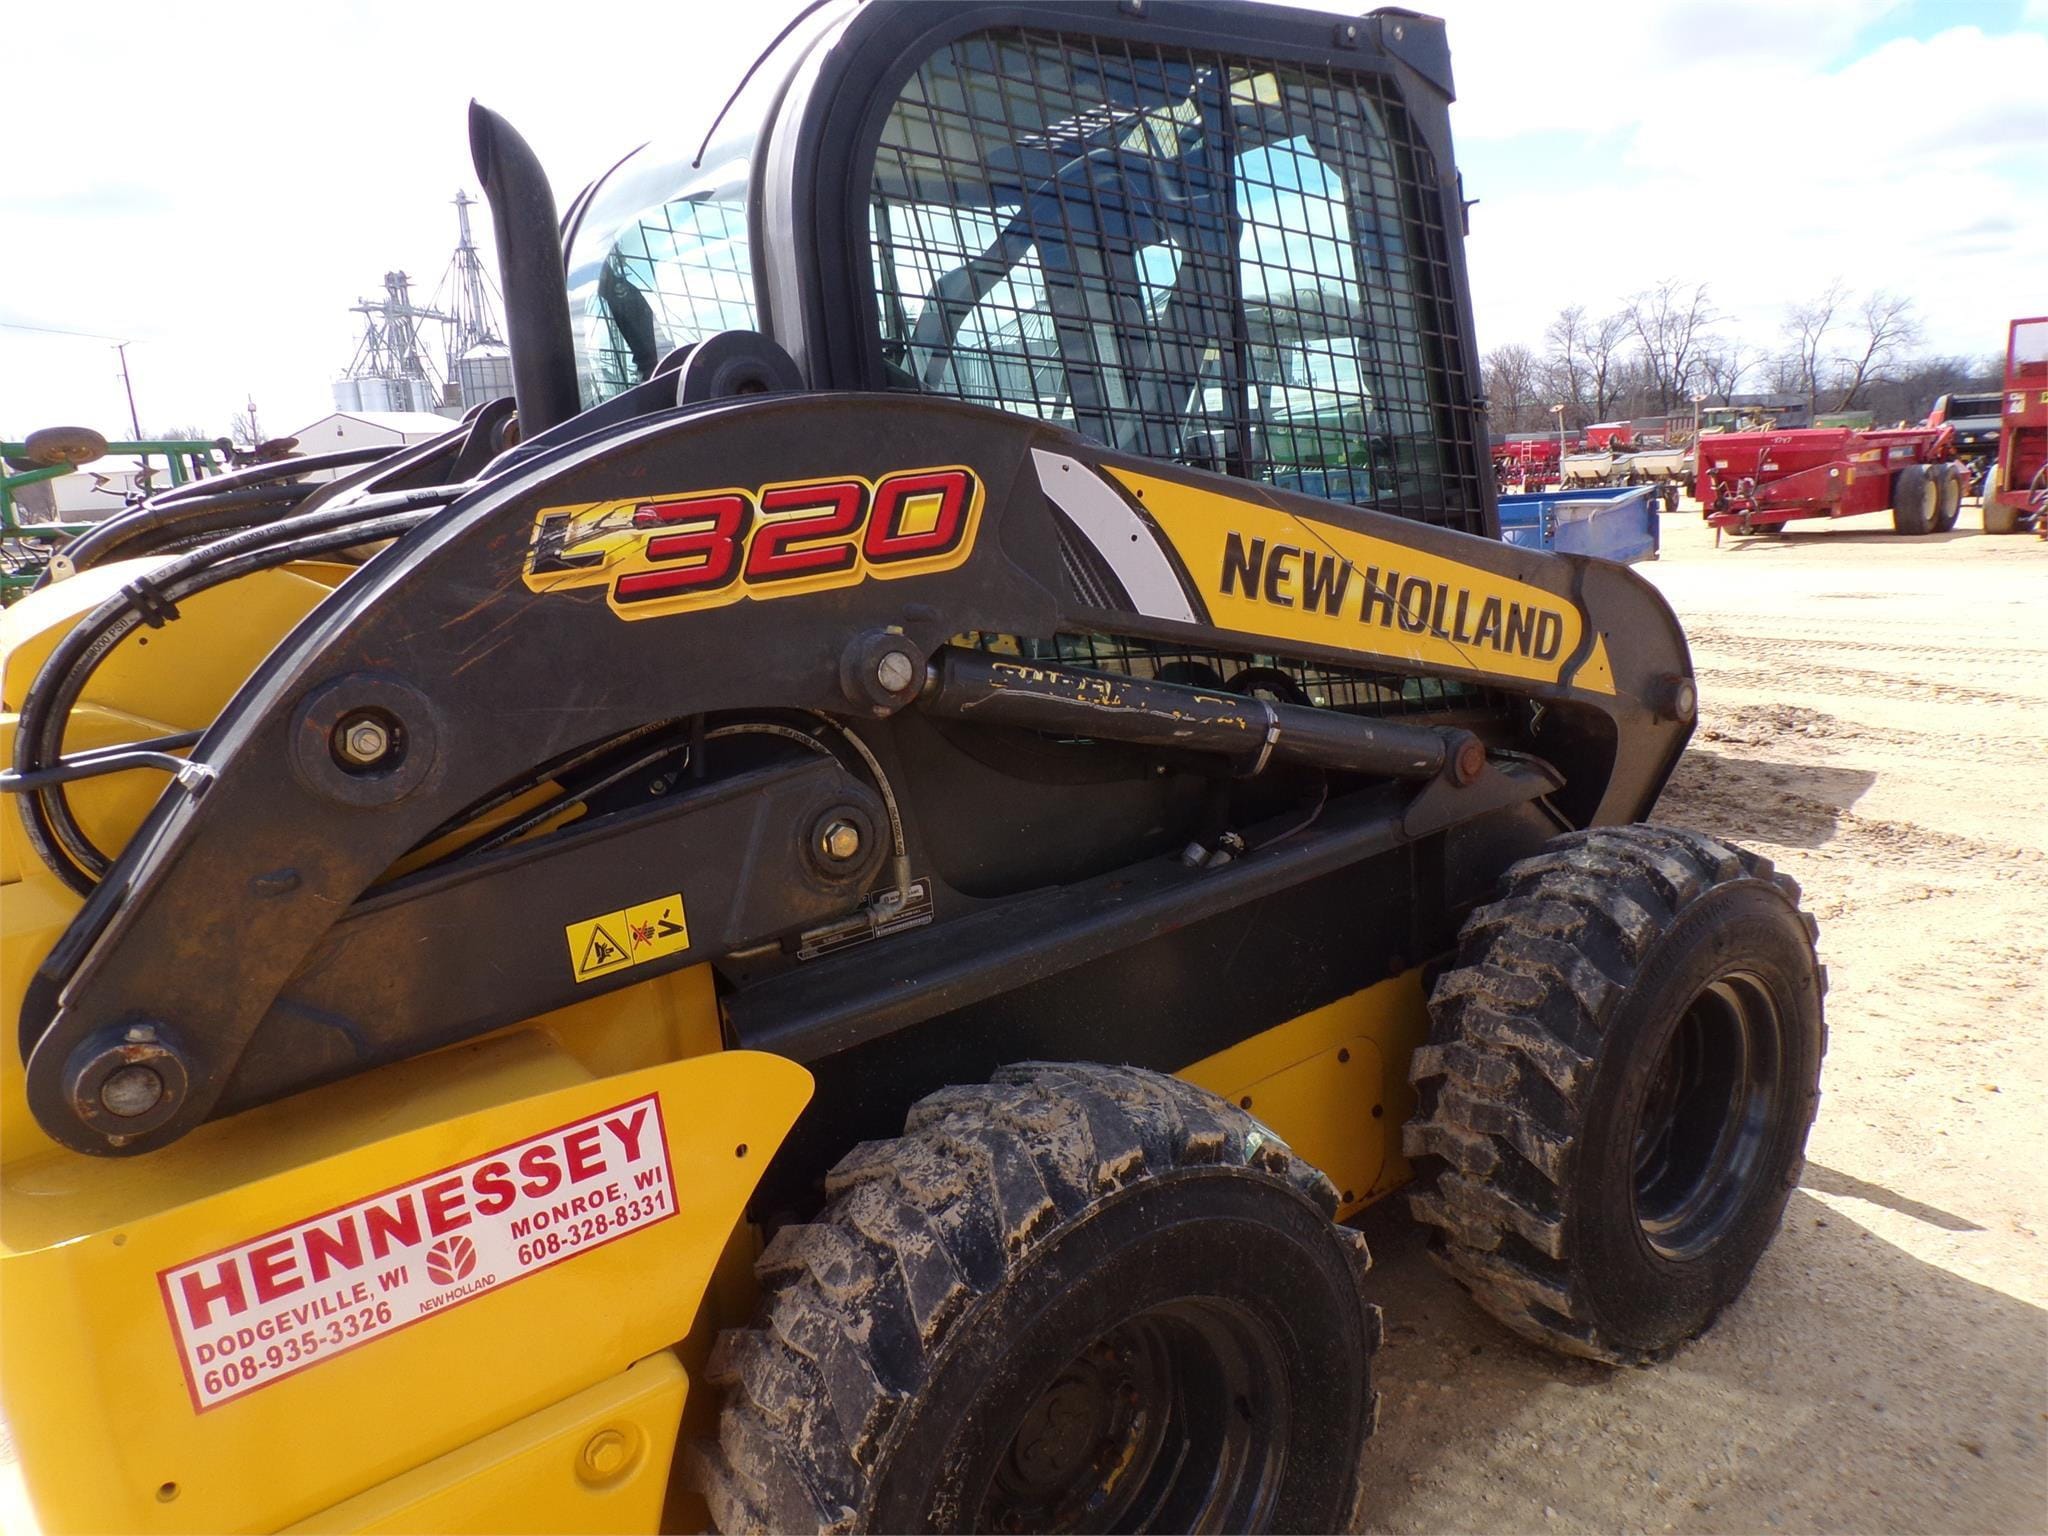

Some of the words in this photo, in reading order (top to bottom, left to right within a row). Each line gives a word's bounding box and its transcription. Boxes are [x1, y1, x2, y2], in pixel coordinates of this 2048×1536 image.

[1219, 530, 1353, 618] NEW
[1359, 565, 1564, 662] HOLLAND
[180, 1107, 648, 1330] HENNESSEY
[510, 1183, 628, 1240] MONROE,
[632, 1166, 663, 1197] WI
[517, 1189, 668, 1266] 608-328-8331
[195, 1282, 376, 1365] DODGEVILLE,
[377, 1264, 409, 1292] WI
[419, 1294, 444, 1313] NEW
[445, 1273, 496, 1303] HOLLAND
[203, 1301, 393, 1396] 608-935-3326
